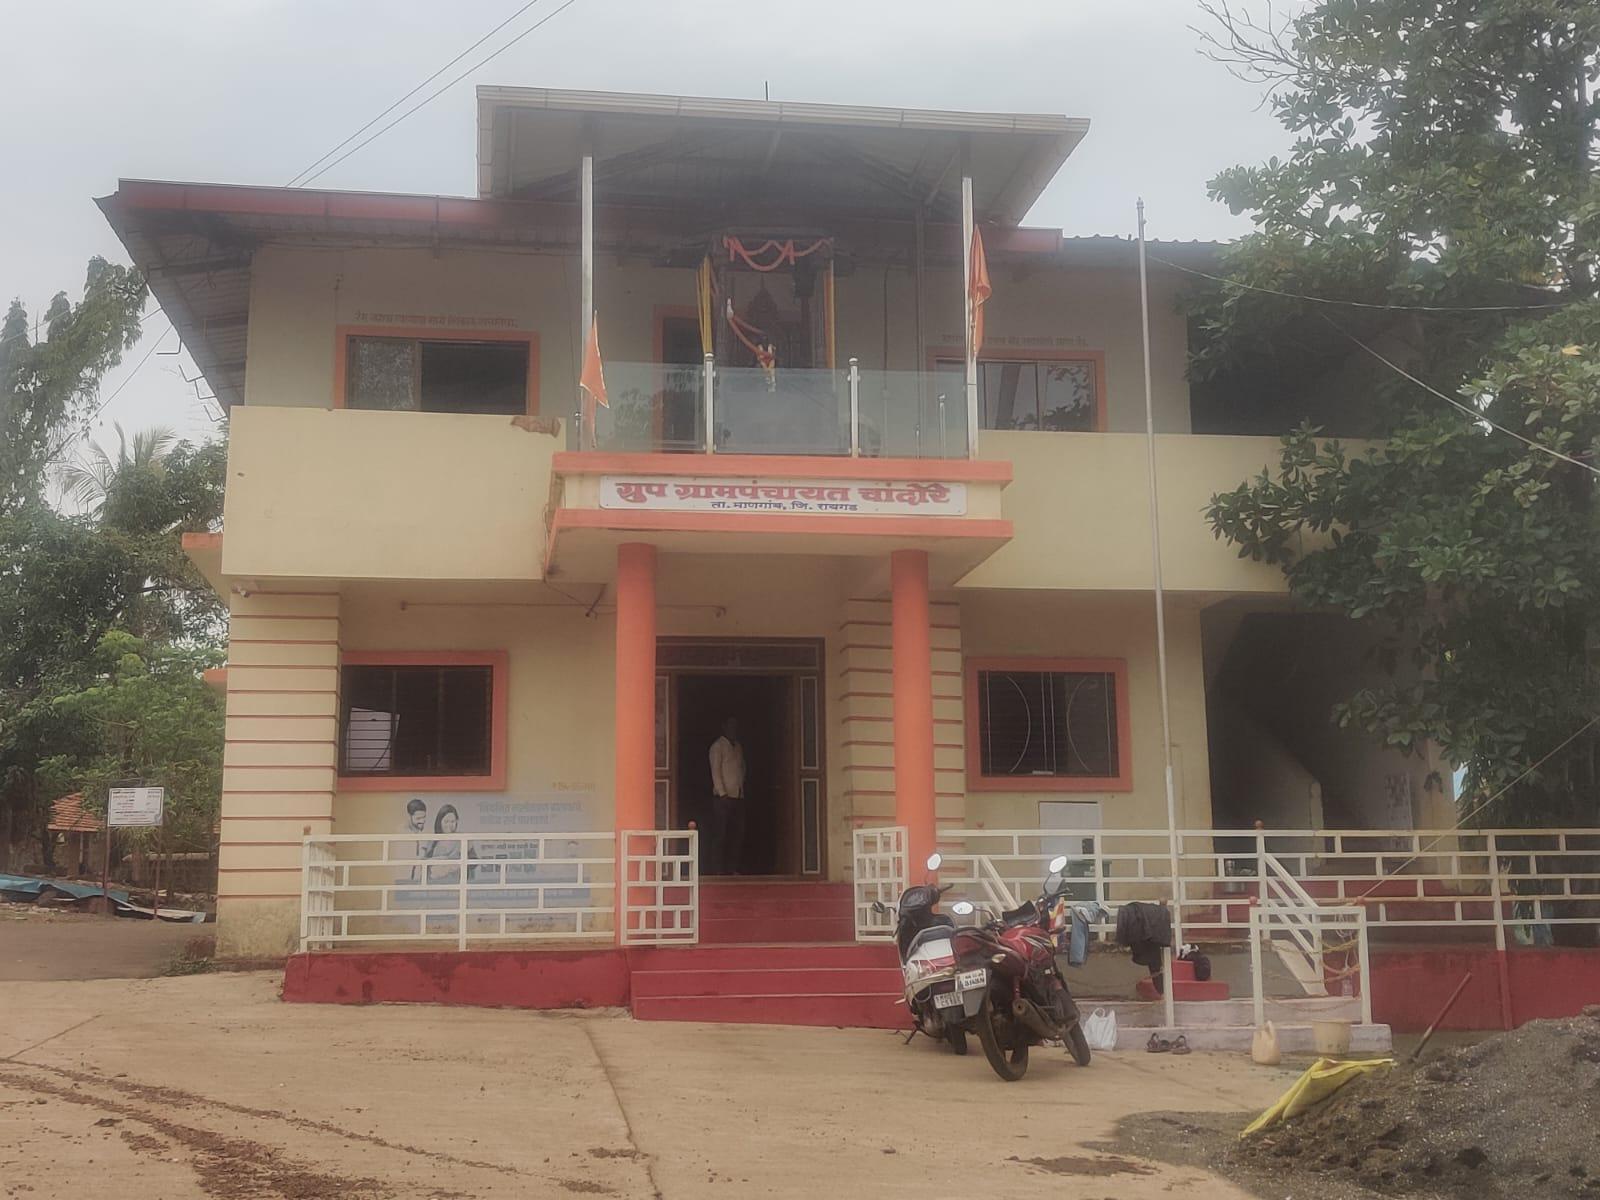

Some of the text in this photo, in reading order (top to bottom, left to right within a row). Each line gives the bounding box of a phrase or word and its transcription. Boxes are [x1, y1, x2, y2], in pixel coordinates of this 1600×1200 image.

[615, 482, 669, 503] ग्रुप
[674, 479, 852, 502] ग्रामपंचायत
[710, 501, 731, 509] ता.
[791, 500, 813, 511] जि.
[816, 502, 858, 511] रायगड
